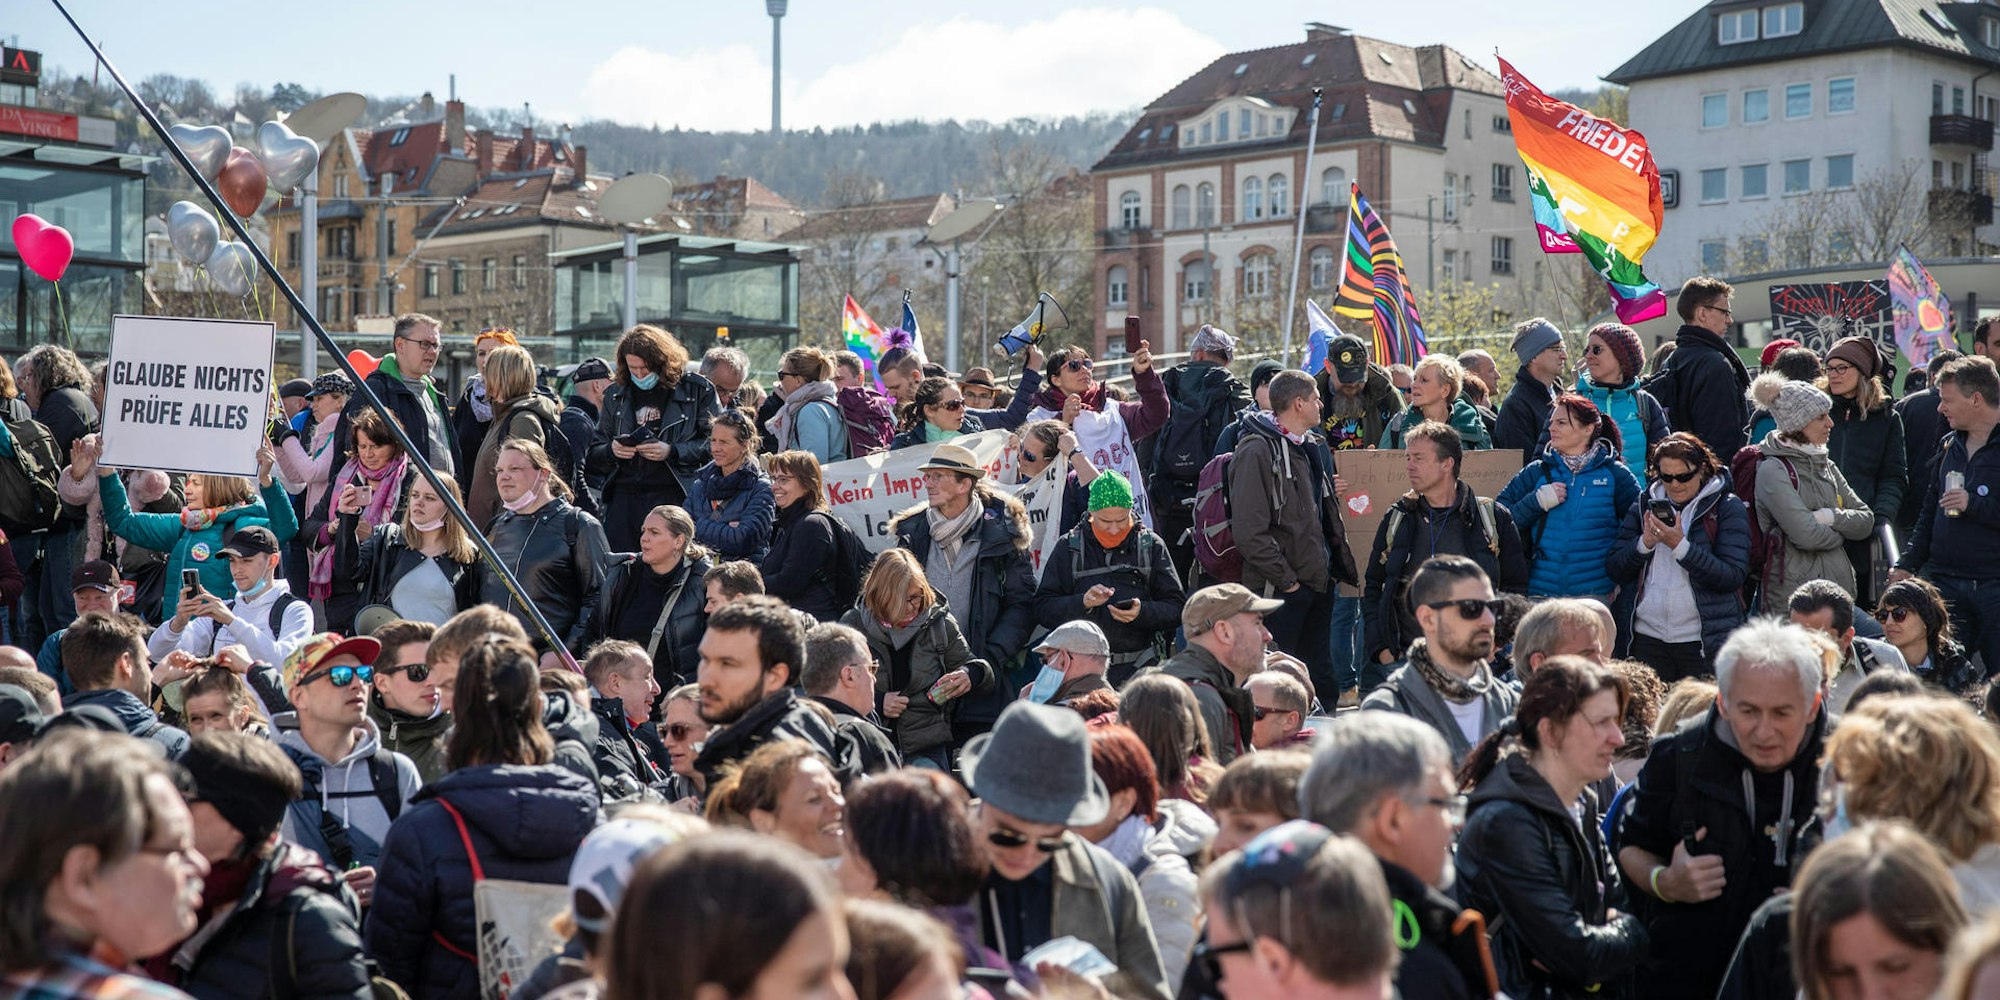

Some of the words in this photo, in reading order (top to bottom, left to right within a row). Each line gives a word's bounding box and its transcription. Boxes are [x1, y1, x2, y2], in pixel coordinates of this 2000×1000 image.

[18, 115, 63, 138] VINCI
[113, 360, 187, 389] GLAUBE
[194, 365, 265, 394] NICHTS
[120, 394, 182, 426] PRÜFE
[189, 403, 249, 431] ALLES
[827, 479, 874, 506] Kein
[864, 509, 894, 538] Ic
